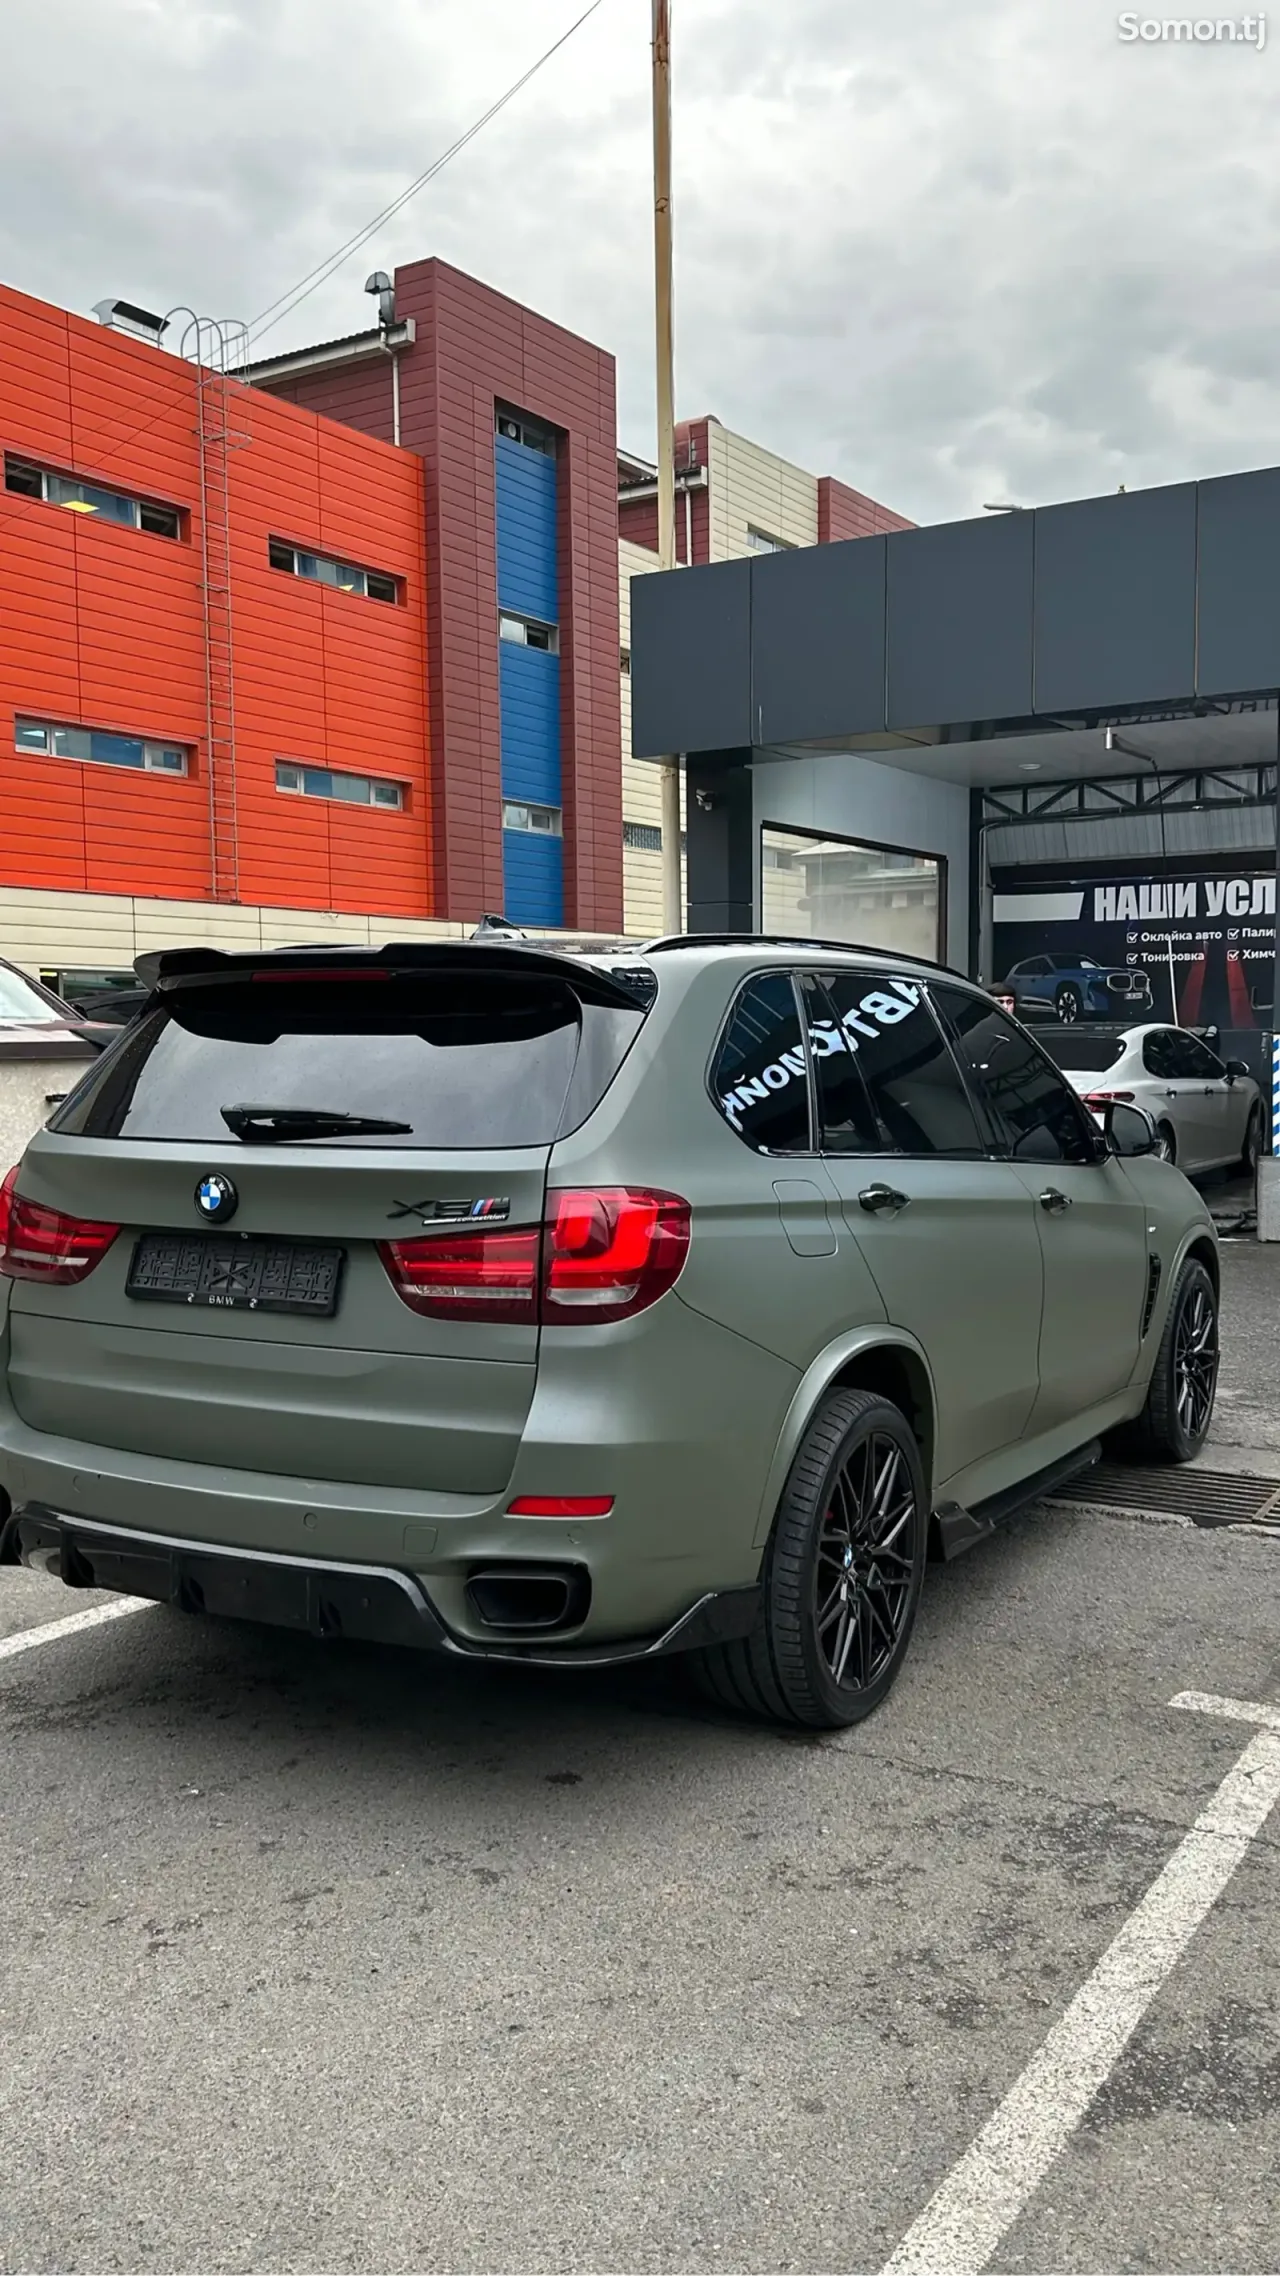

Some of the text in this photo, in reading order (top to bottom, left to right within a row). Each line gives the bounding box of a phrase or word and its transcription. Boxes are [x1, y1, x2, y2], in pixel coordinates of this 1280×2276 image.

[1094, 878, 1276, 922] НАШИ УСЛ
[1195, 931, 1223, 940] авто
[1242, 927, 1276, 938] Пали
[1141, 952, 1205, 963] Тонировка
[208, 1294, 235, 1306] BMW
